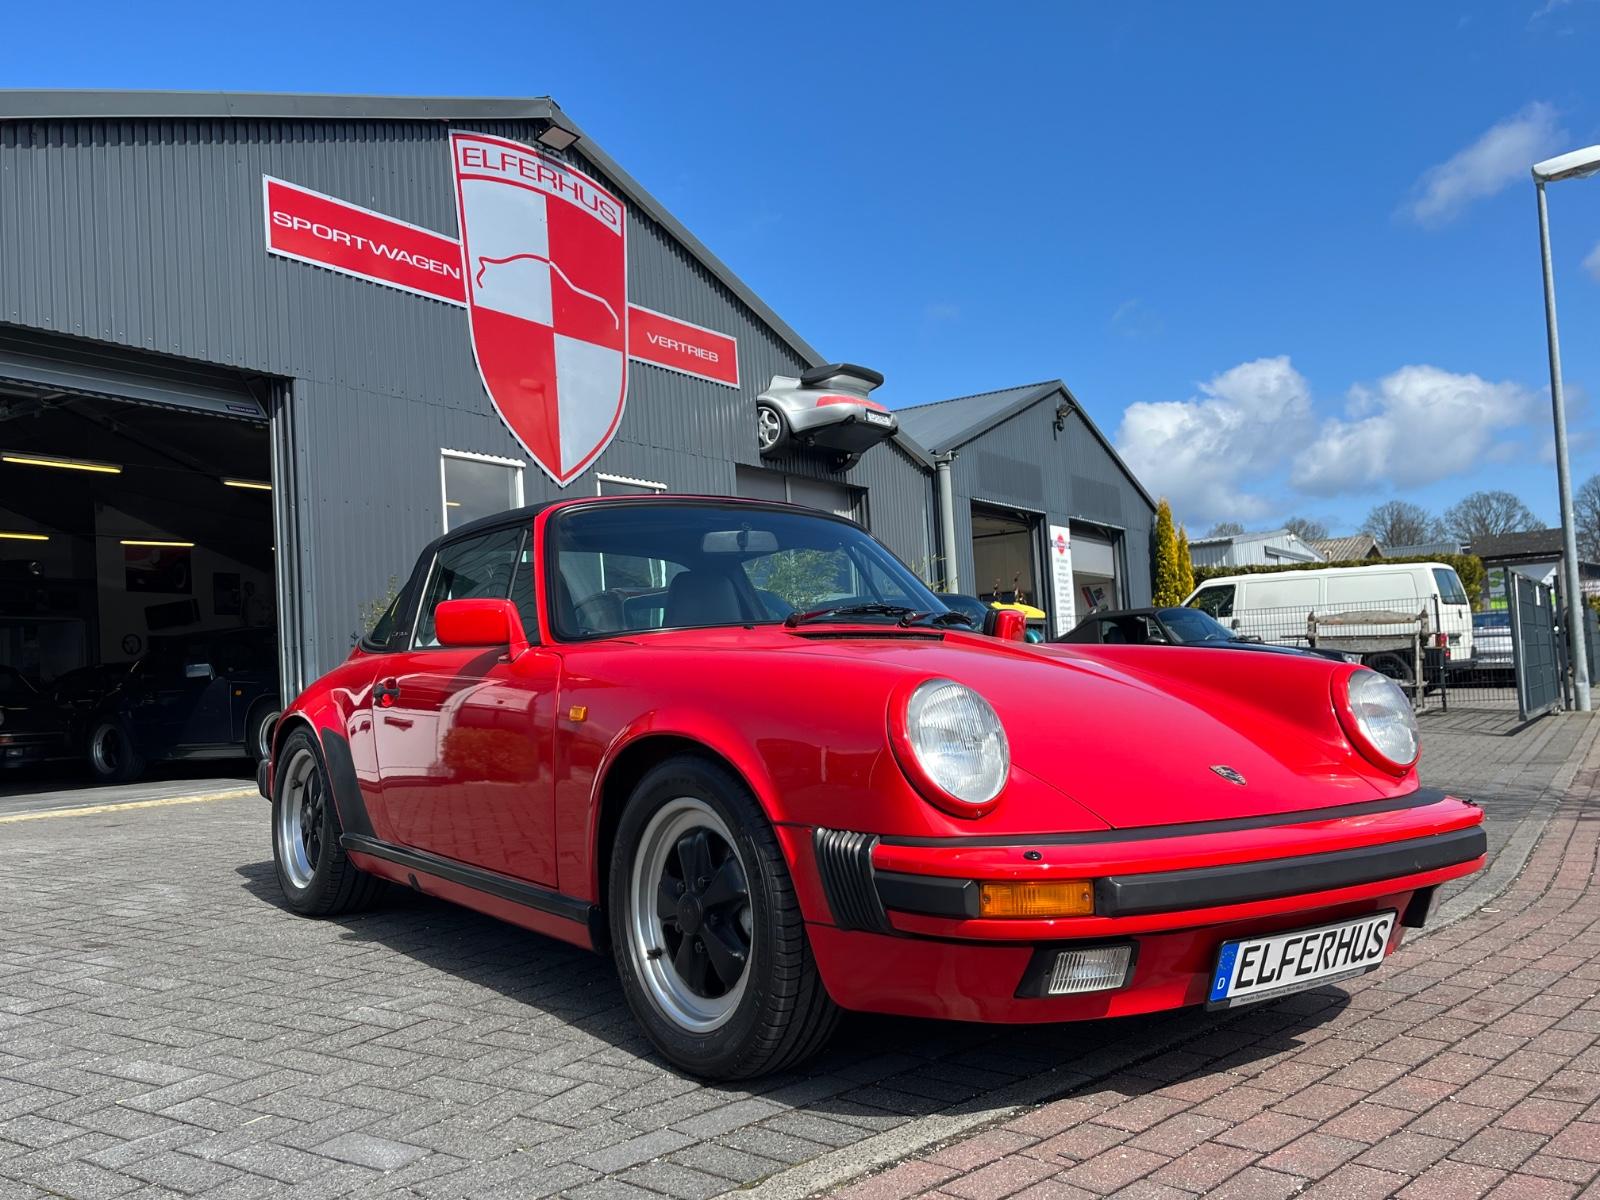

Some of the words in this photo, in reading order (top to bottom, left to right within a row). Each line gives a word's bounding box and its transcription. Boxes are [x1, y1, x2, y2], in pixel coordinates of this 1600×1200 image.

[462, 147, 620, 226] ELFERHUS
[272, 210, 461, 280] SPORTWAGEN
[646, 331, 720, 364] VERTRIEB
[1216, 977, 1225, 990] D
[1234, 919, 1389, 990] ELFERHUS
